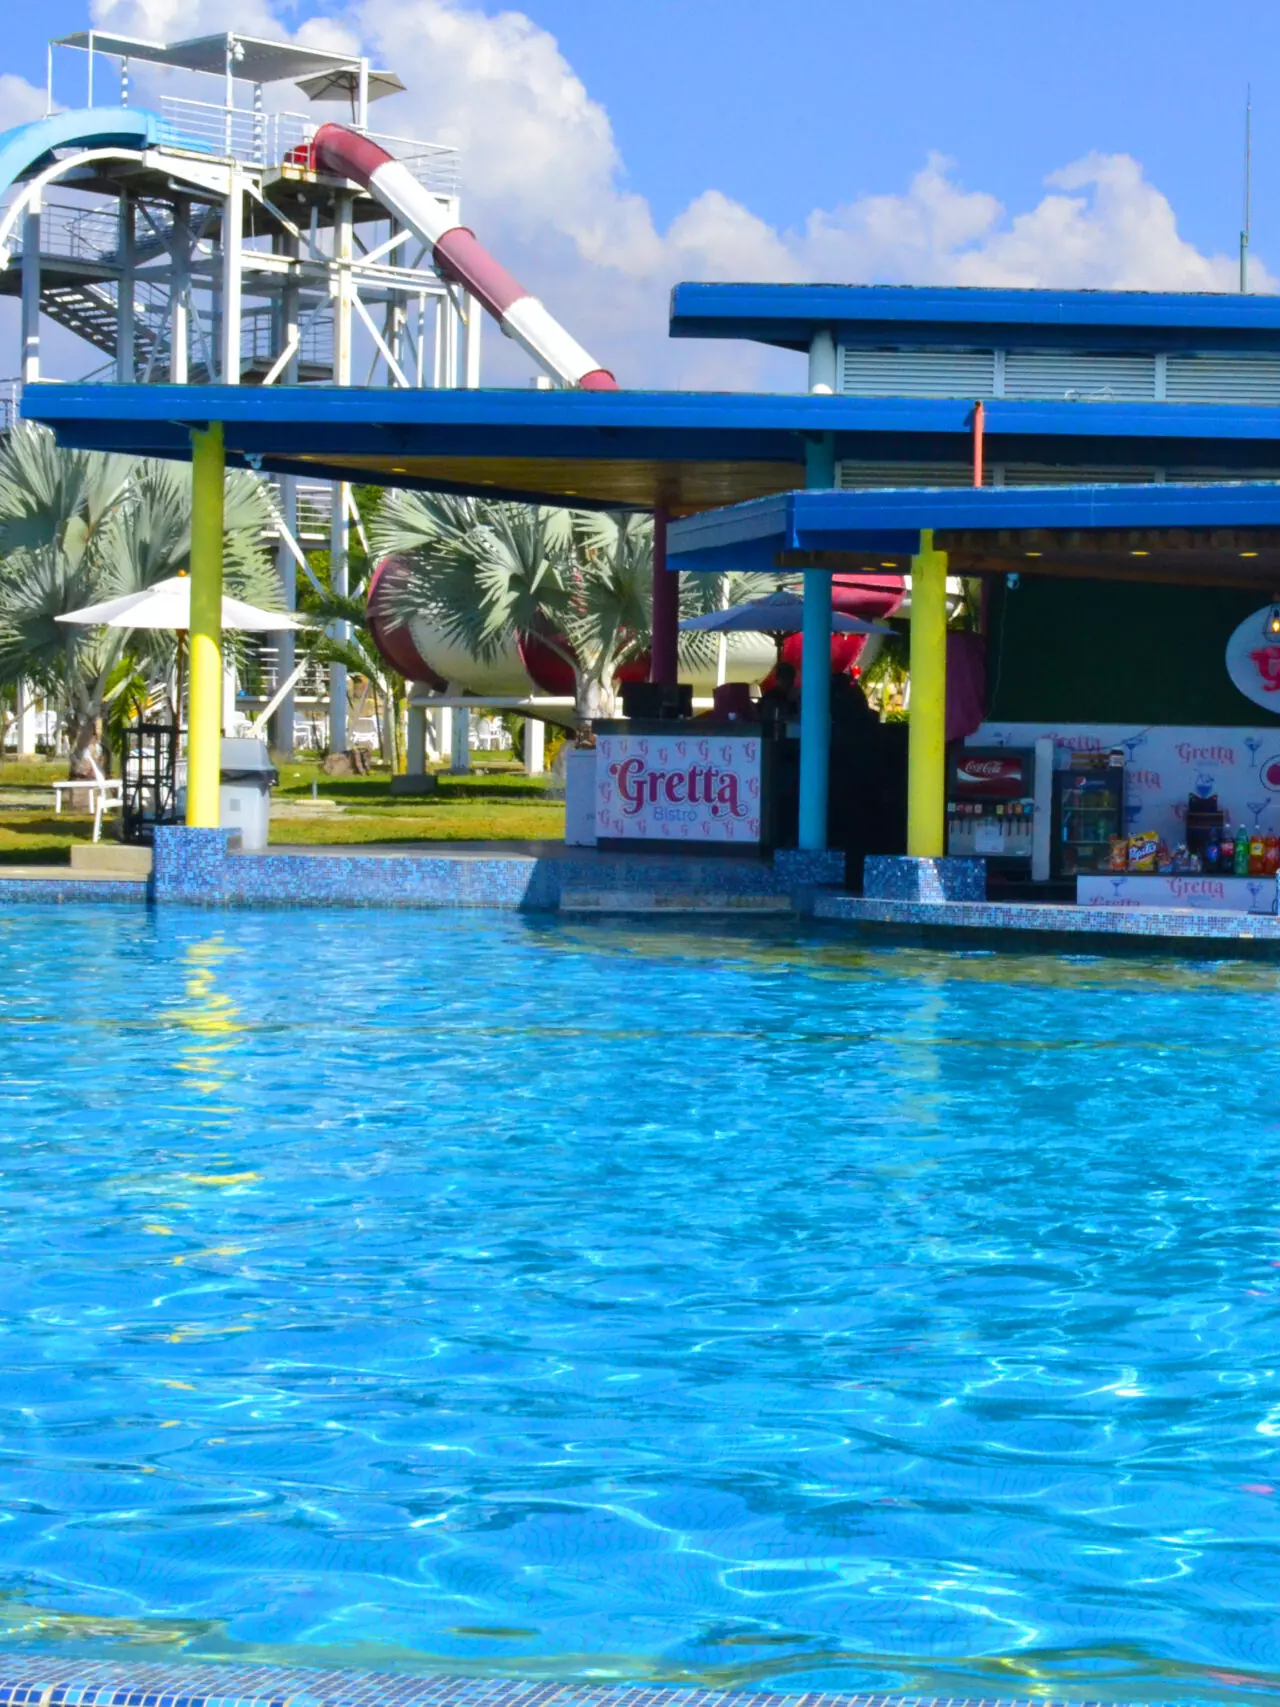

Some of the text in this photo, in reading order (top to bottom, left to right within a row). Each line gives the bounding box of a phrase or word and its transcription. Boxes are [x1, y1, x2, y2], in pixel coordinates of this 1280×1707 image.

[1174, 742, 1235, 765] Gretta
[609, 758, 749, 817] Gretta
[653, 806, 698, 821] Bistro
[1167, 876, 1225, 898] Gretta
